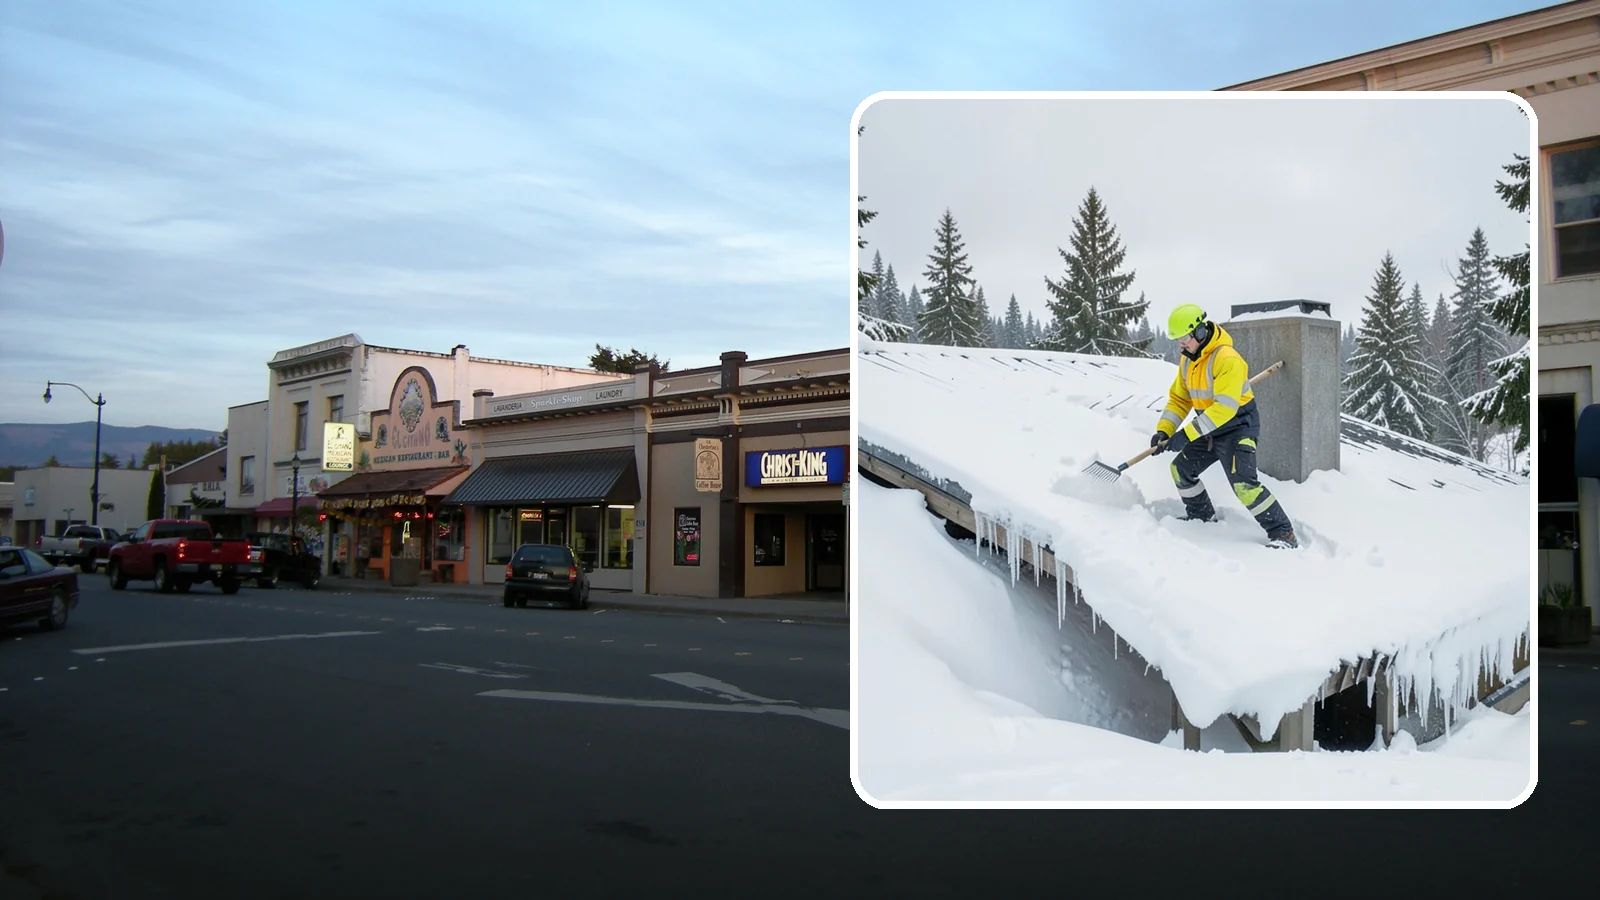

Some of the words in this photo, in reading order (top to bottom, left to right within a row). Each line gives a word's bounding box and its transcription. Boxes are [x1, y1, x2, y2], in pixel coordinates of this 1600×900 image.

[561, 394, 583, 405] Shop
[595, 389, 624, 400] LAUNDRY
[493, 402, 523, 413] LAVANDERIA
[373, 455, 396, 464] MEXICAN
[397, 451, 434, 462] RESTAURANT
[437, 450, 450, 459] BAR
[697, 480, 709, 488] Coffee
